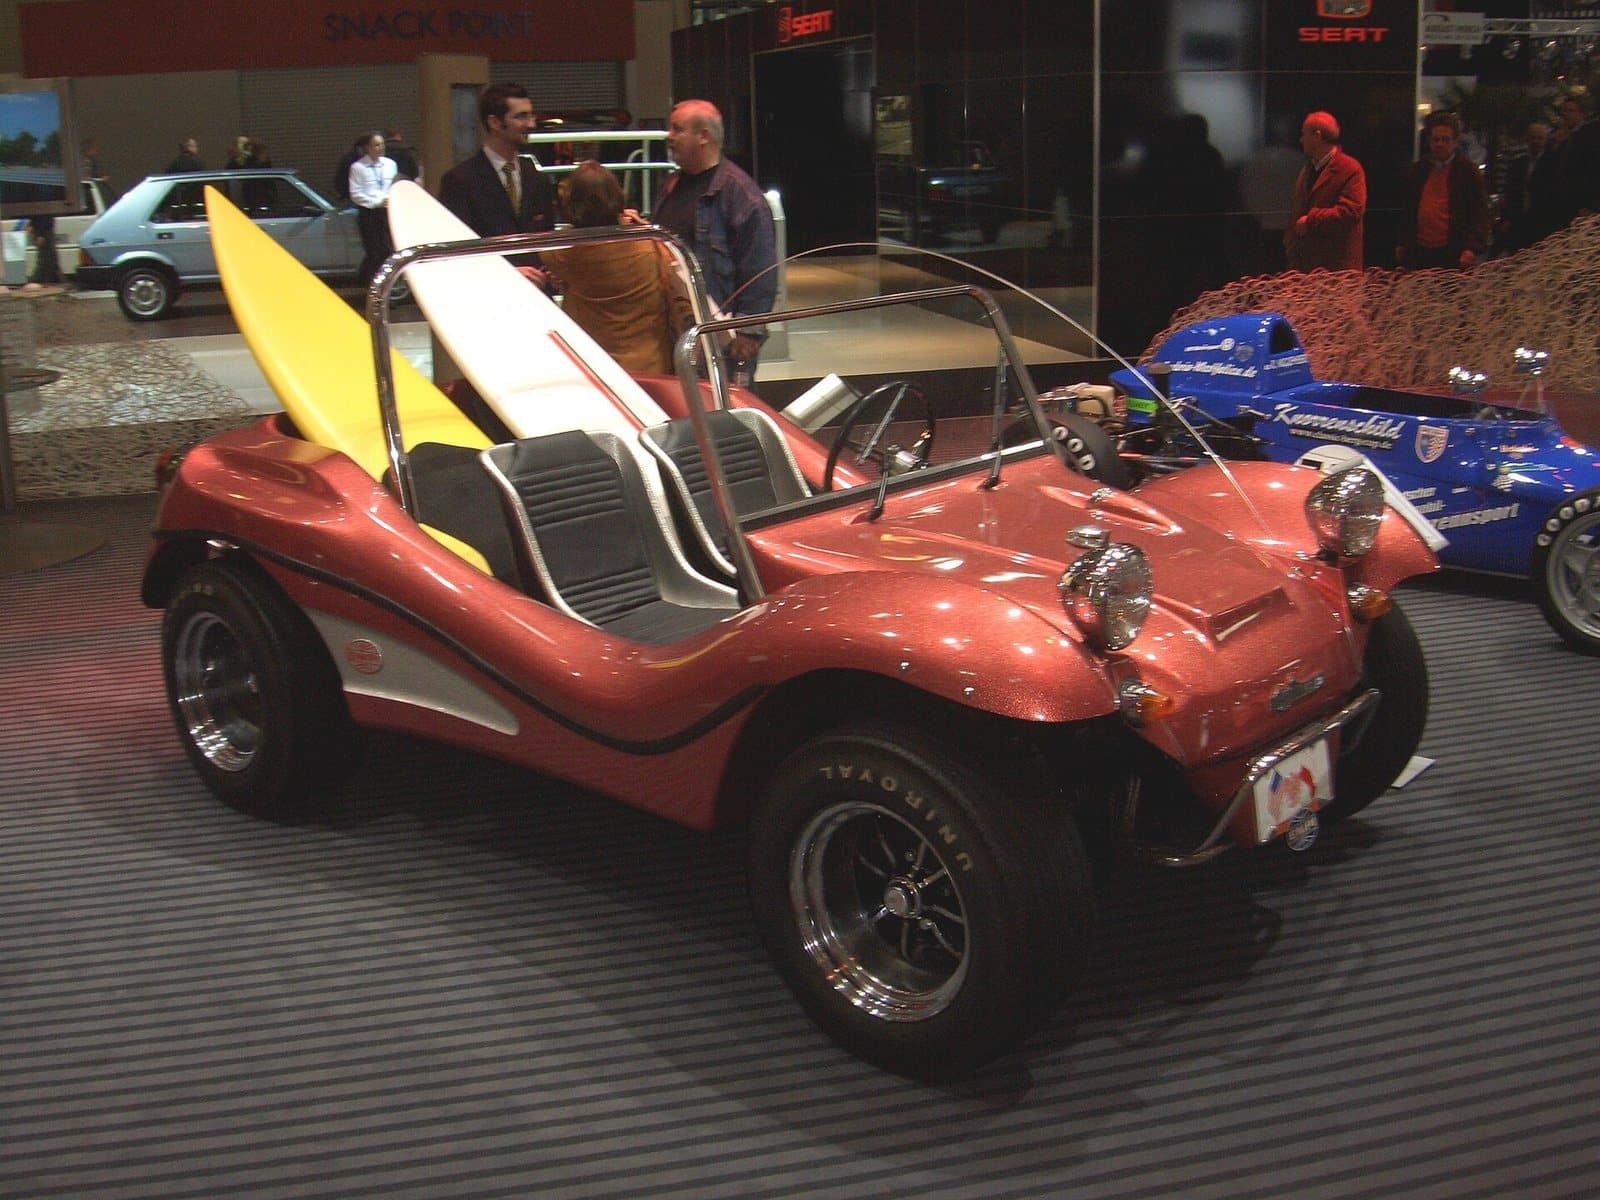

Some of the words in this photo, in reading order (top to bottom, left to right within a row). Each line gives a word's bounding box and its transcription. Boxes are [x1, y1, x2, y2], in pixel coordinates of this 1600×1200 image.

[322, 10, 440, 42] SNACK
[448, 9, 536, 39] POINT
[791, 9, 833, 37] SEAT
[1298, 26, 1390, 43] SEAT
[818, 765, 974, 872] UNIROYAL
